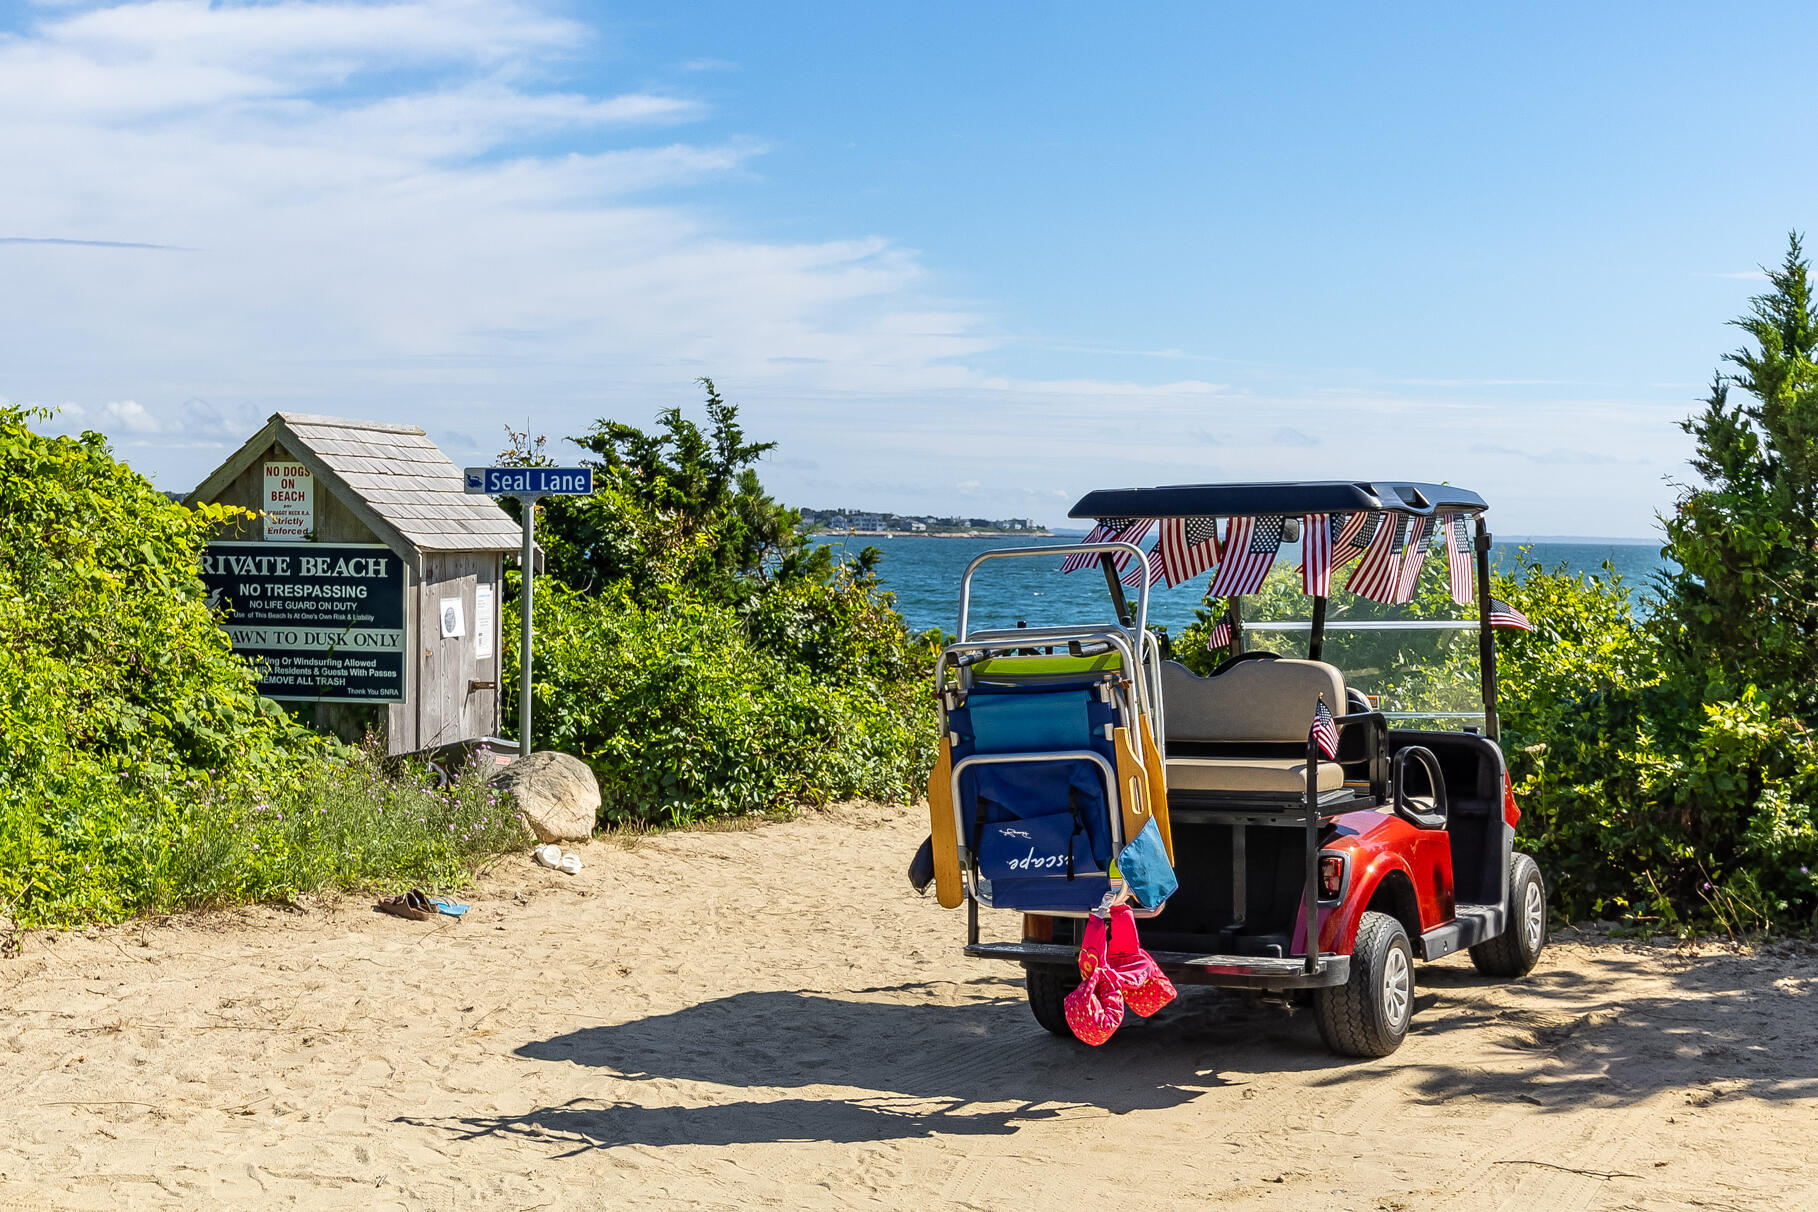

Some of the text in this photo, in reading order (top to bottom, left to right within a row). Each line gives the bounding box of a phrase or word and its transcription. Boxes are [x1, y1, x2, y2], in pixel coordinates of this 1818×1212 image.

[266, 466, 311, 477] NO DOGS
[281, 478, 295, 489] ON
[490, 471, 585, 491] Seal Lane
[271, 491, 305, 502] BEACH
[272, 517, 304, 527] Strictly
[267, 527, 309, 535] Enforced
[200, 555, 388, 578] RIVATE BEACH
[240, 583, 368, 598] NO TRESPASSING
[249, 600, 358, 611] NO LIFE GUARD ON DUTY
[229, 630, 400, 648] AWN TO DUSK ONLY
[250, 656, 377, 668] oating Or Windsurfing Allowed
[274, 666, 312, 675] Residents
[313, 667, 320, 675] &
[321, 668, 348, 676] Guests
[349, 668, 368, 677] With
[369, 669, 397, 678] Passes
[296, 677, 314, 685] ALL
[315, 677, 346, 686] TRASH
[347, 687, 399, 696] Thank You SNRA
[1008, 846, 1075, 870] scape
